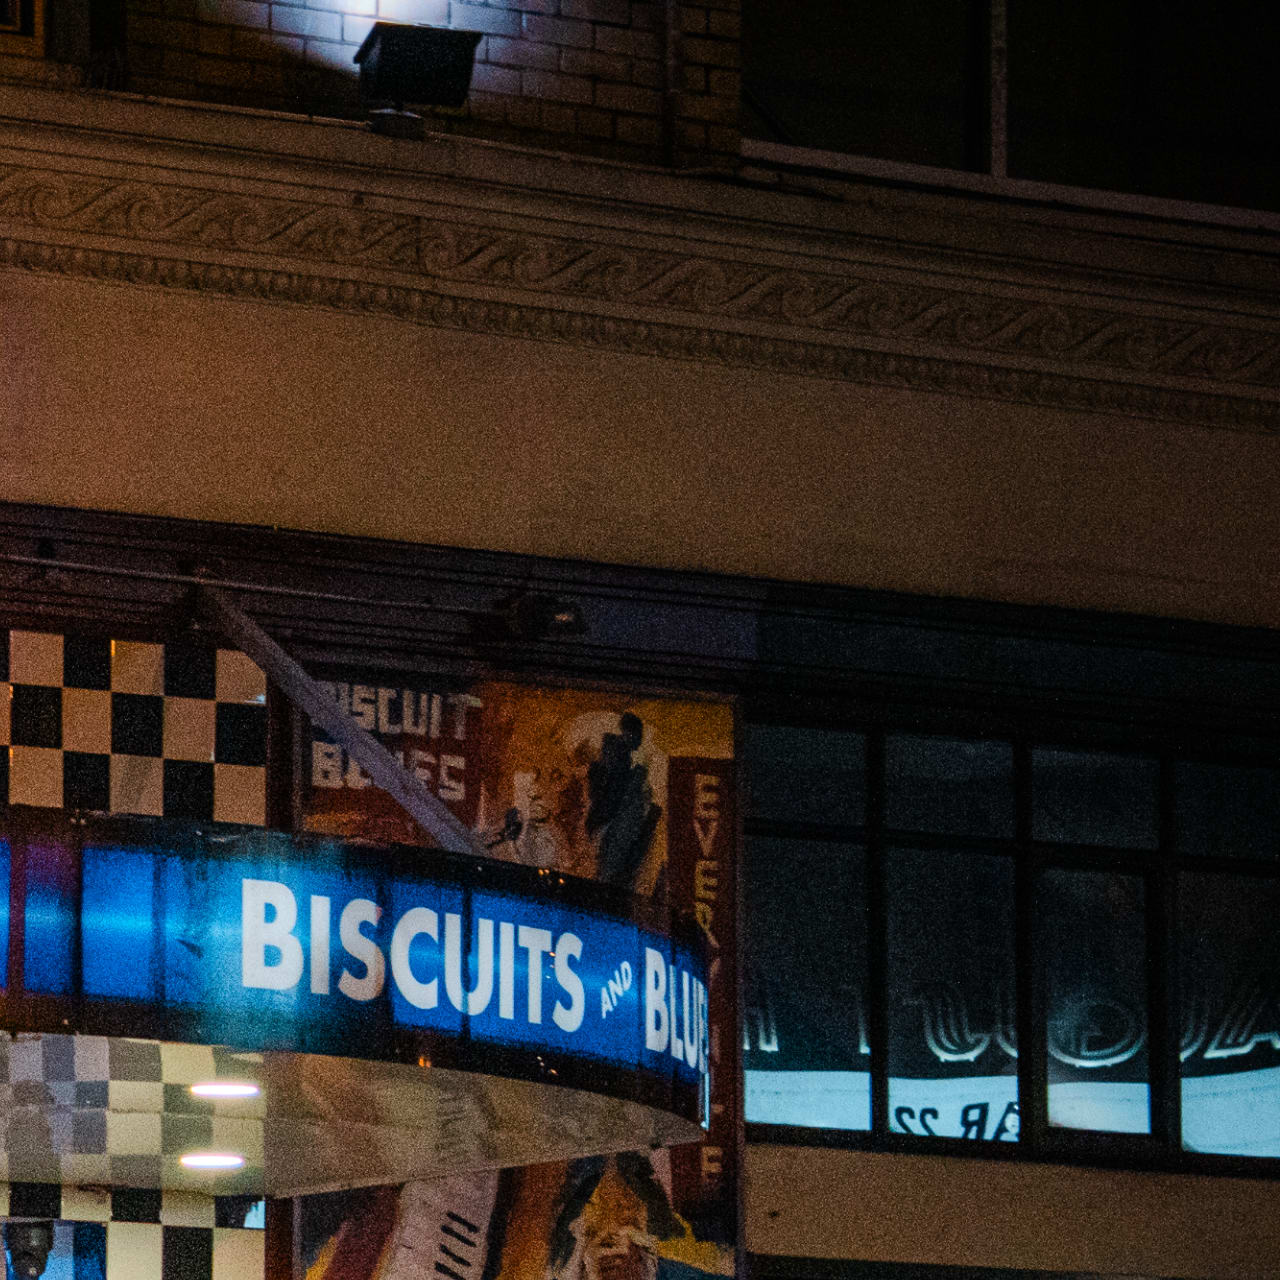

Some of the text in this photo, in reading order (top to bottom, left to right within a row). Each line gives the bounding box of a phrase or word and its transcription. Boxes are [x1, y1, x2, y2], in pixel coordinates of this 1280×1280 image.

[311, 741, 466, 801] BLES
[241, 878, 586, 1033] BISCUITS
[600, 960, 634, 1020] AND
